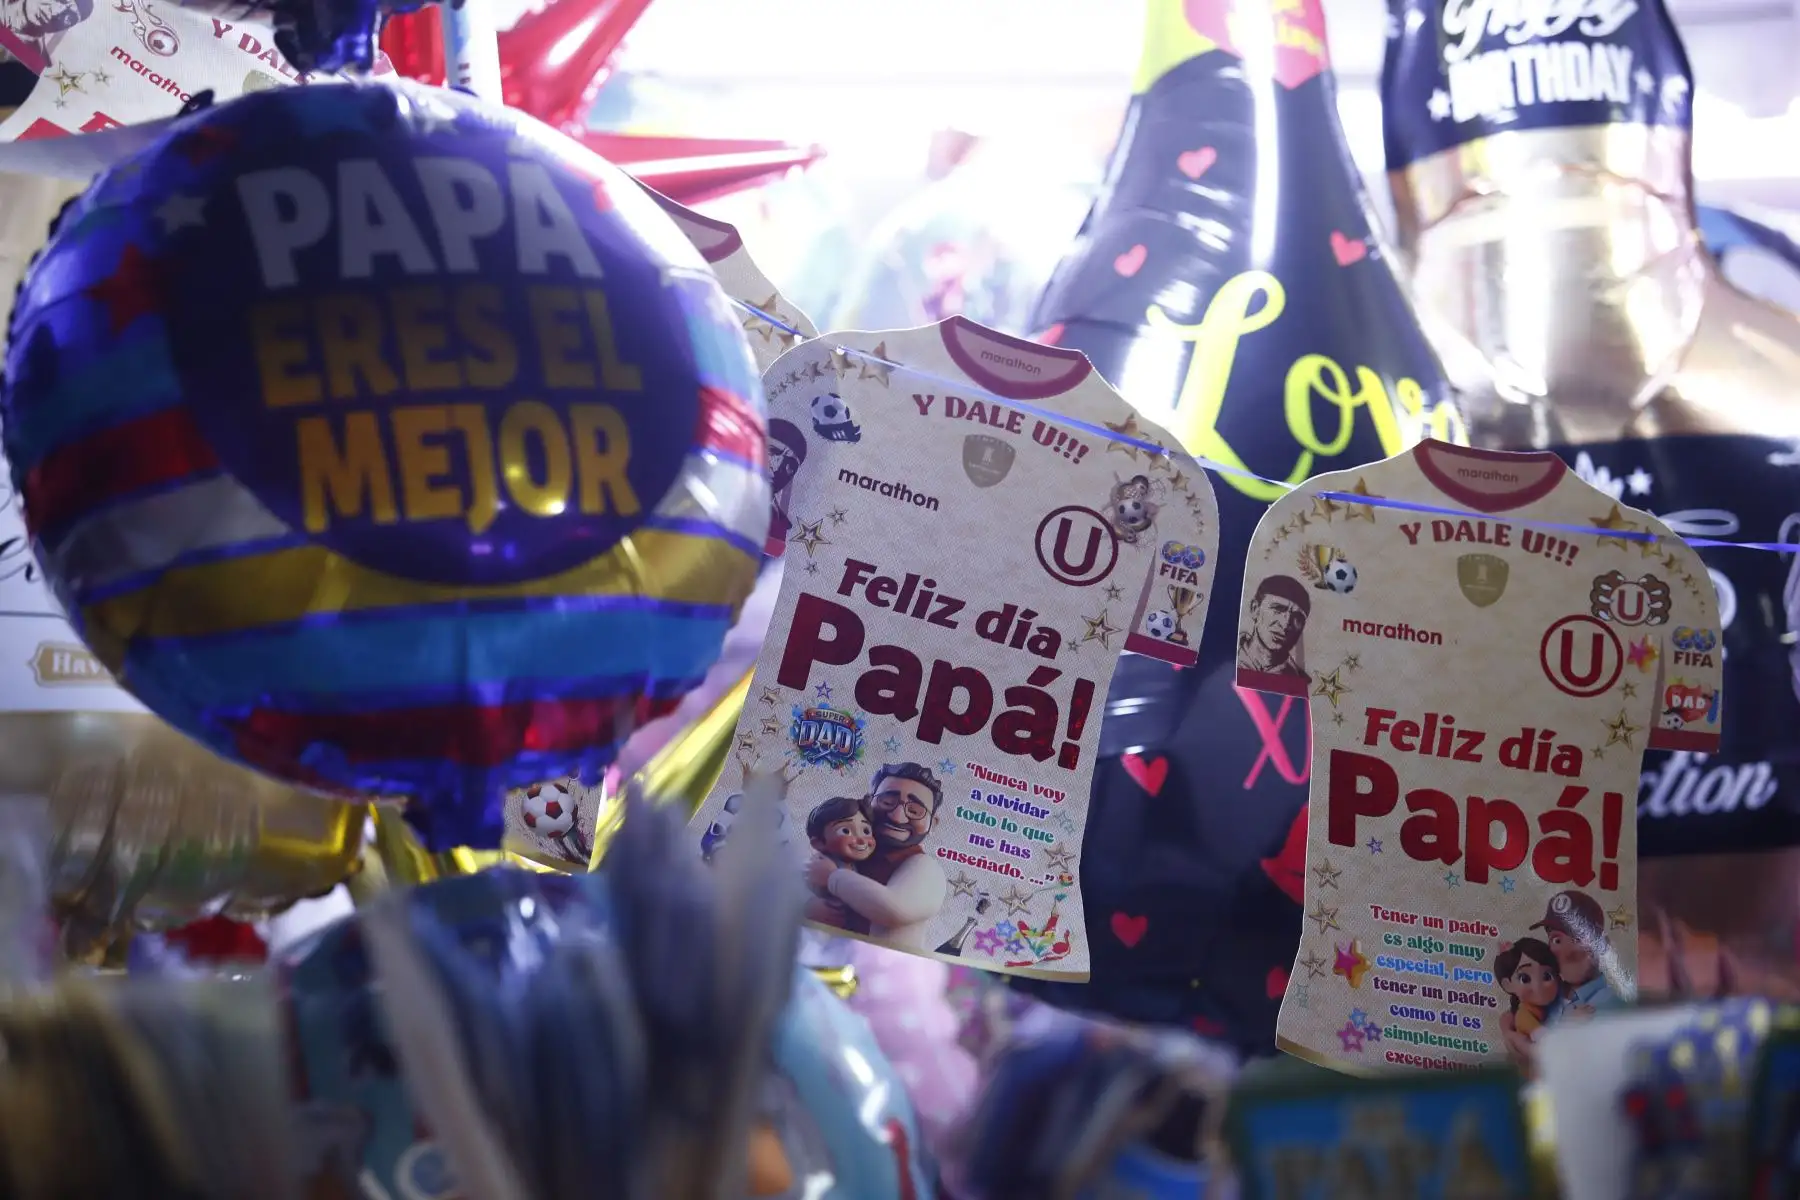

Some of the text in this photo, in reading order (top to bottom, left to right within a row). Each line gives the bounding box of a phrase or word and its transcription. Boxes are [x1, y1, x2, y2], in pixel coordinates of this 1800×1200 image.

[212, 18, 233, 39] Y
[110, 46, 193, 105] maratho
[251, 287, 642, 407] ERES EL
[981, 351, 1041, 375] marathon
[912, 394, 935, 416] Y
[945, 396, 1025, 434] DALE
[1032, 420, 1089, 464] U!!!
[296, 401, 640, 534] MEJOR
[1458, 467, 1518, 482] marathon
[838, 467, 939, 511] marathon
[1400, 524, 1421, 545] Y
[1432, 519, 1511, 546] DALE
[1521, 529, 1579, 566] U!!!
[1159, 563, 1198, 586] FIFA
[836, 558, 1062, 660] Feliz día
[1617, 589, 1643, 621] U
[1342, 617, 1443, 646] marathon
[1674, 651, 1713, 668] FIFA
[777, 592, 1095, 771] Papá!
[815, 709, 845, 721] SUPER
[1671, 694, 1706, 710] DAD
[799, 720, 855, 757] DAD
[1363, 707, 1583, 778] Feliz día
[970, 789, 1050, 819] a olvidar
[1033, 784, 1066, 804] voy
[956, 806, 1054, 843] todo lo que
[1328, 749, 1623, 891] Papá!
[968, 833, 1031, 860] me has
[937, 847, 1025, 880] enseñado.
[1370, 905, 1498, 937] Tener un padre
[1384, 933, 1485, 961] es algo muy
[1376, 955, 1493, 984] especial, pero
[1373, 976, 1497, 1008] tener un padre
[1390, 1004, 1481, 1029] como tú es
[1384, 1025, 1489, 1053] simplemente
[1385, 1050, 1483, 1071] excepcion
